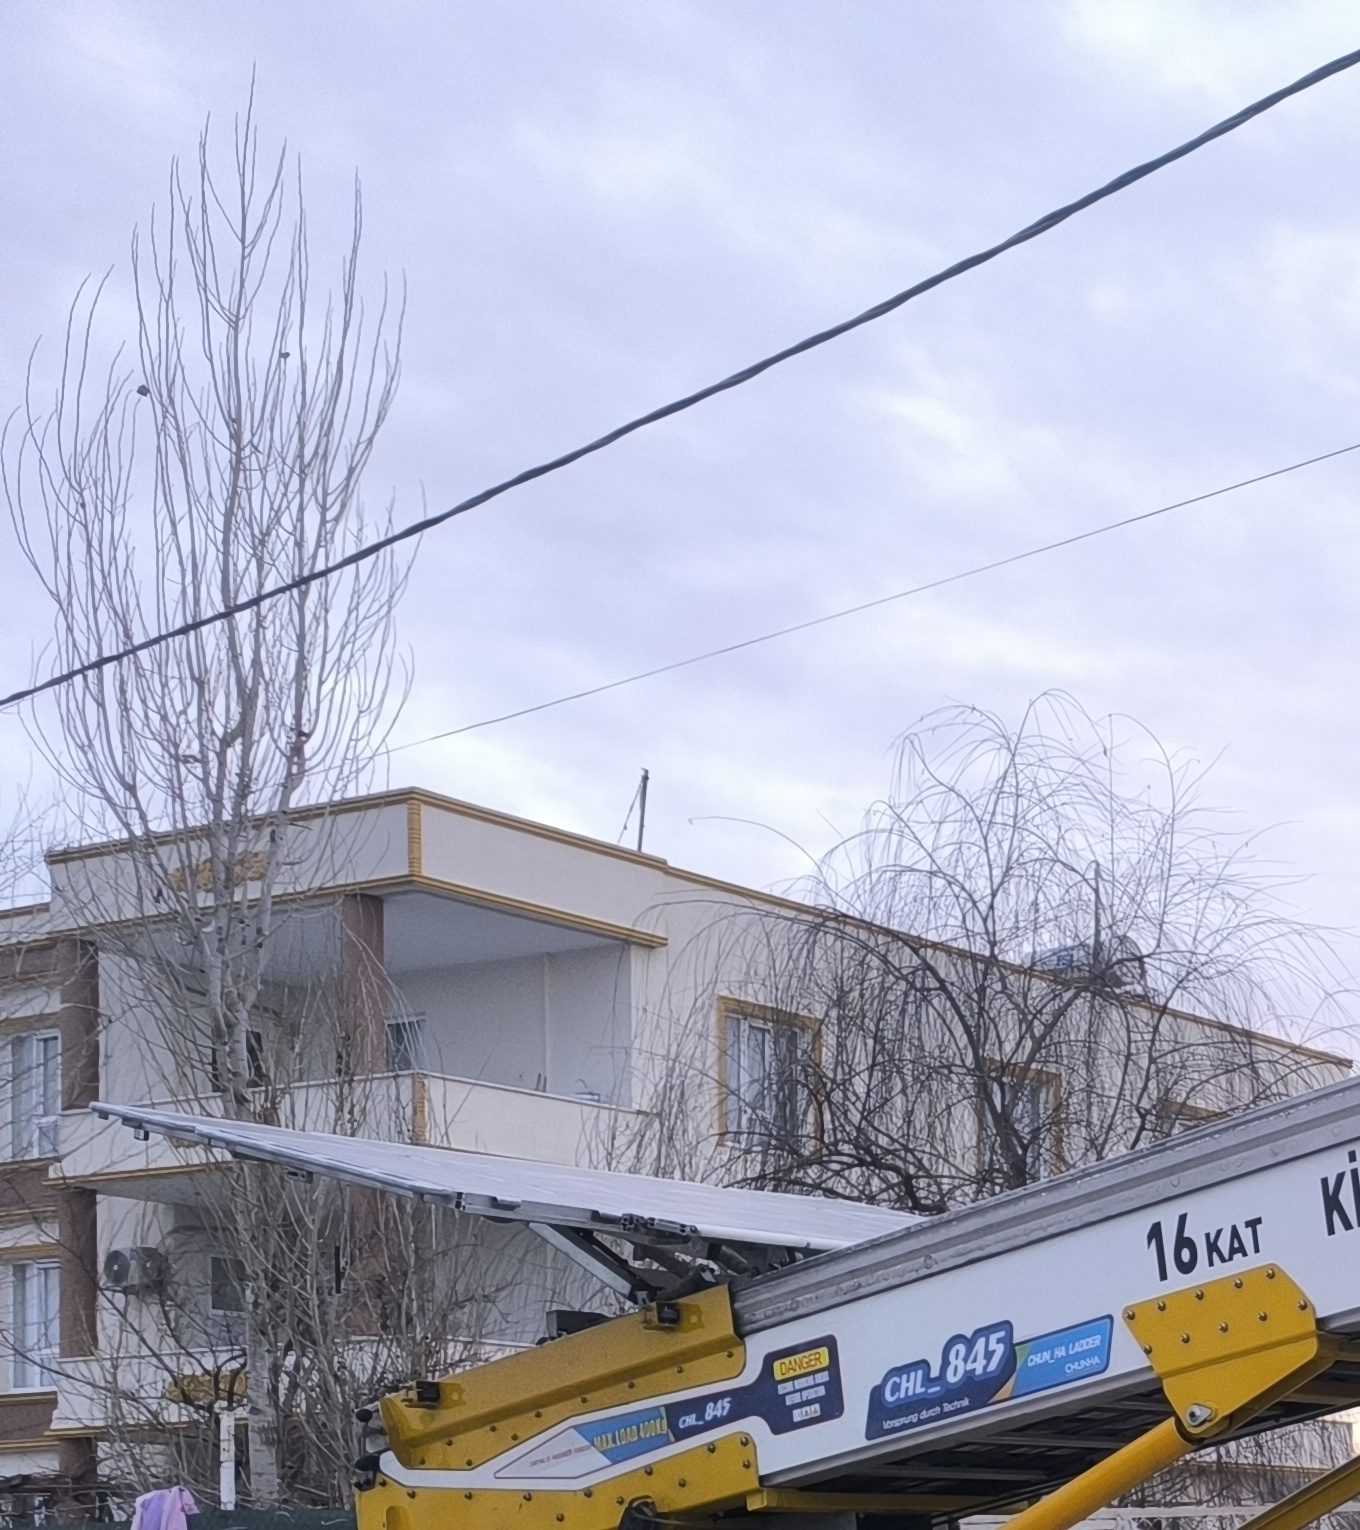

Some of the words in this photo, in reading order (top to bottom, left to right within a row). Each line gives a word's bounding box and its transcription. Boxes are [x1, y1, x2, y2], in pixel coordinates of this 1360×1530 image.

[1146, 1212, 1198, 1282] 16
[1205, 1217, 1263, 1267] KAT
[779, 1352, 823, 1376] DANGER
